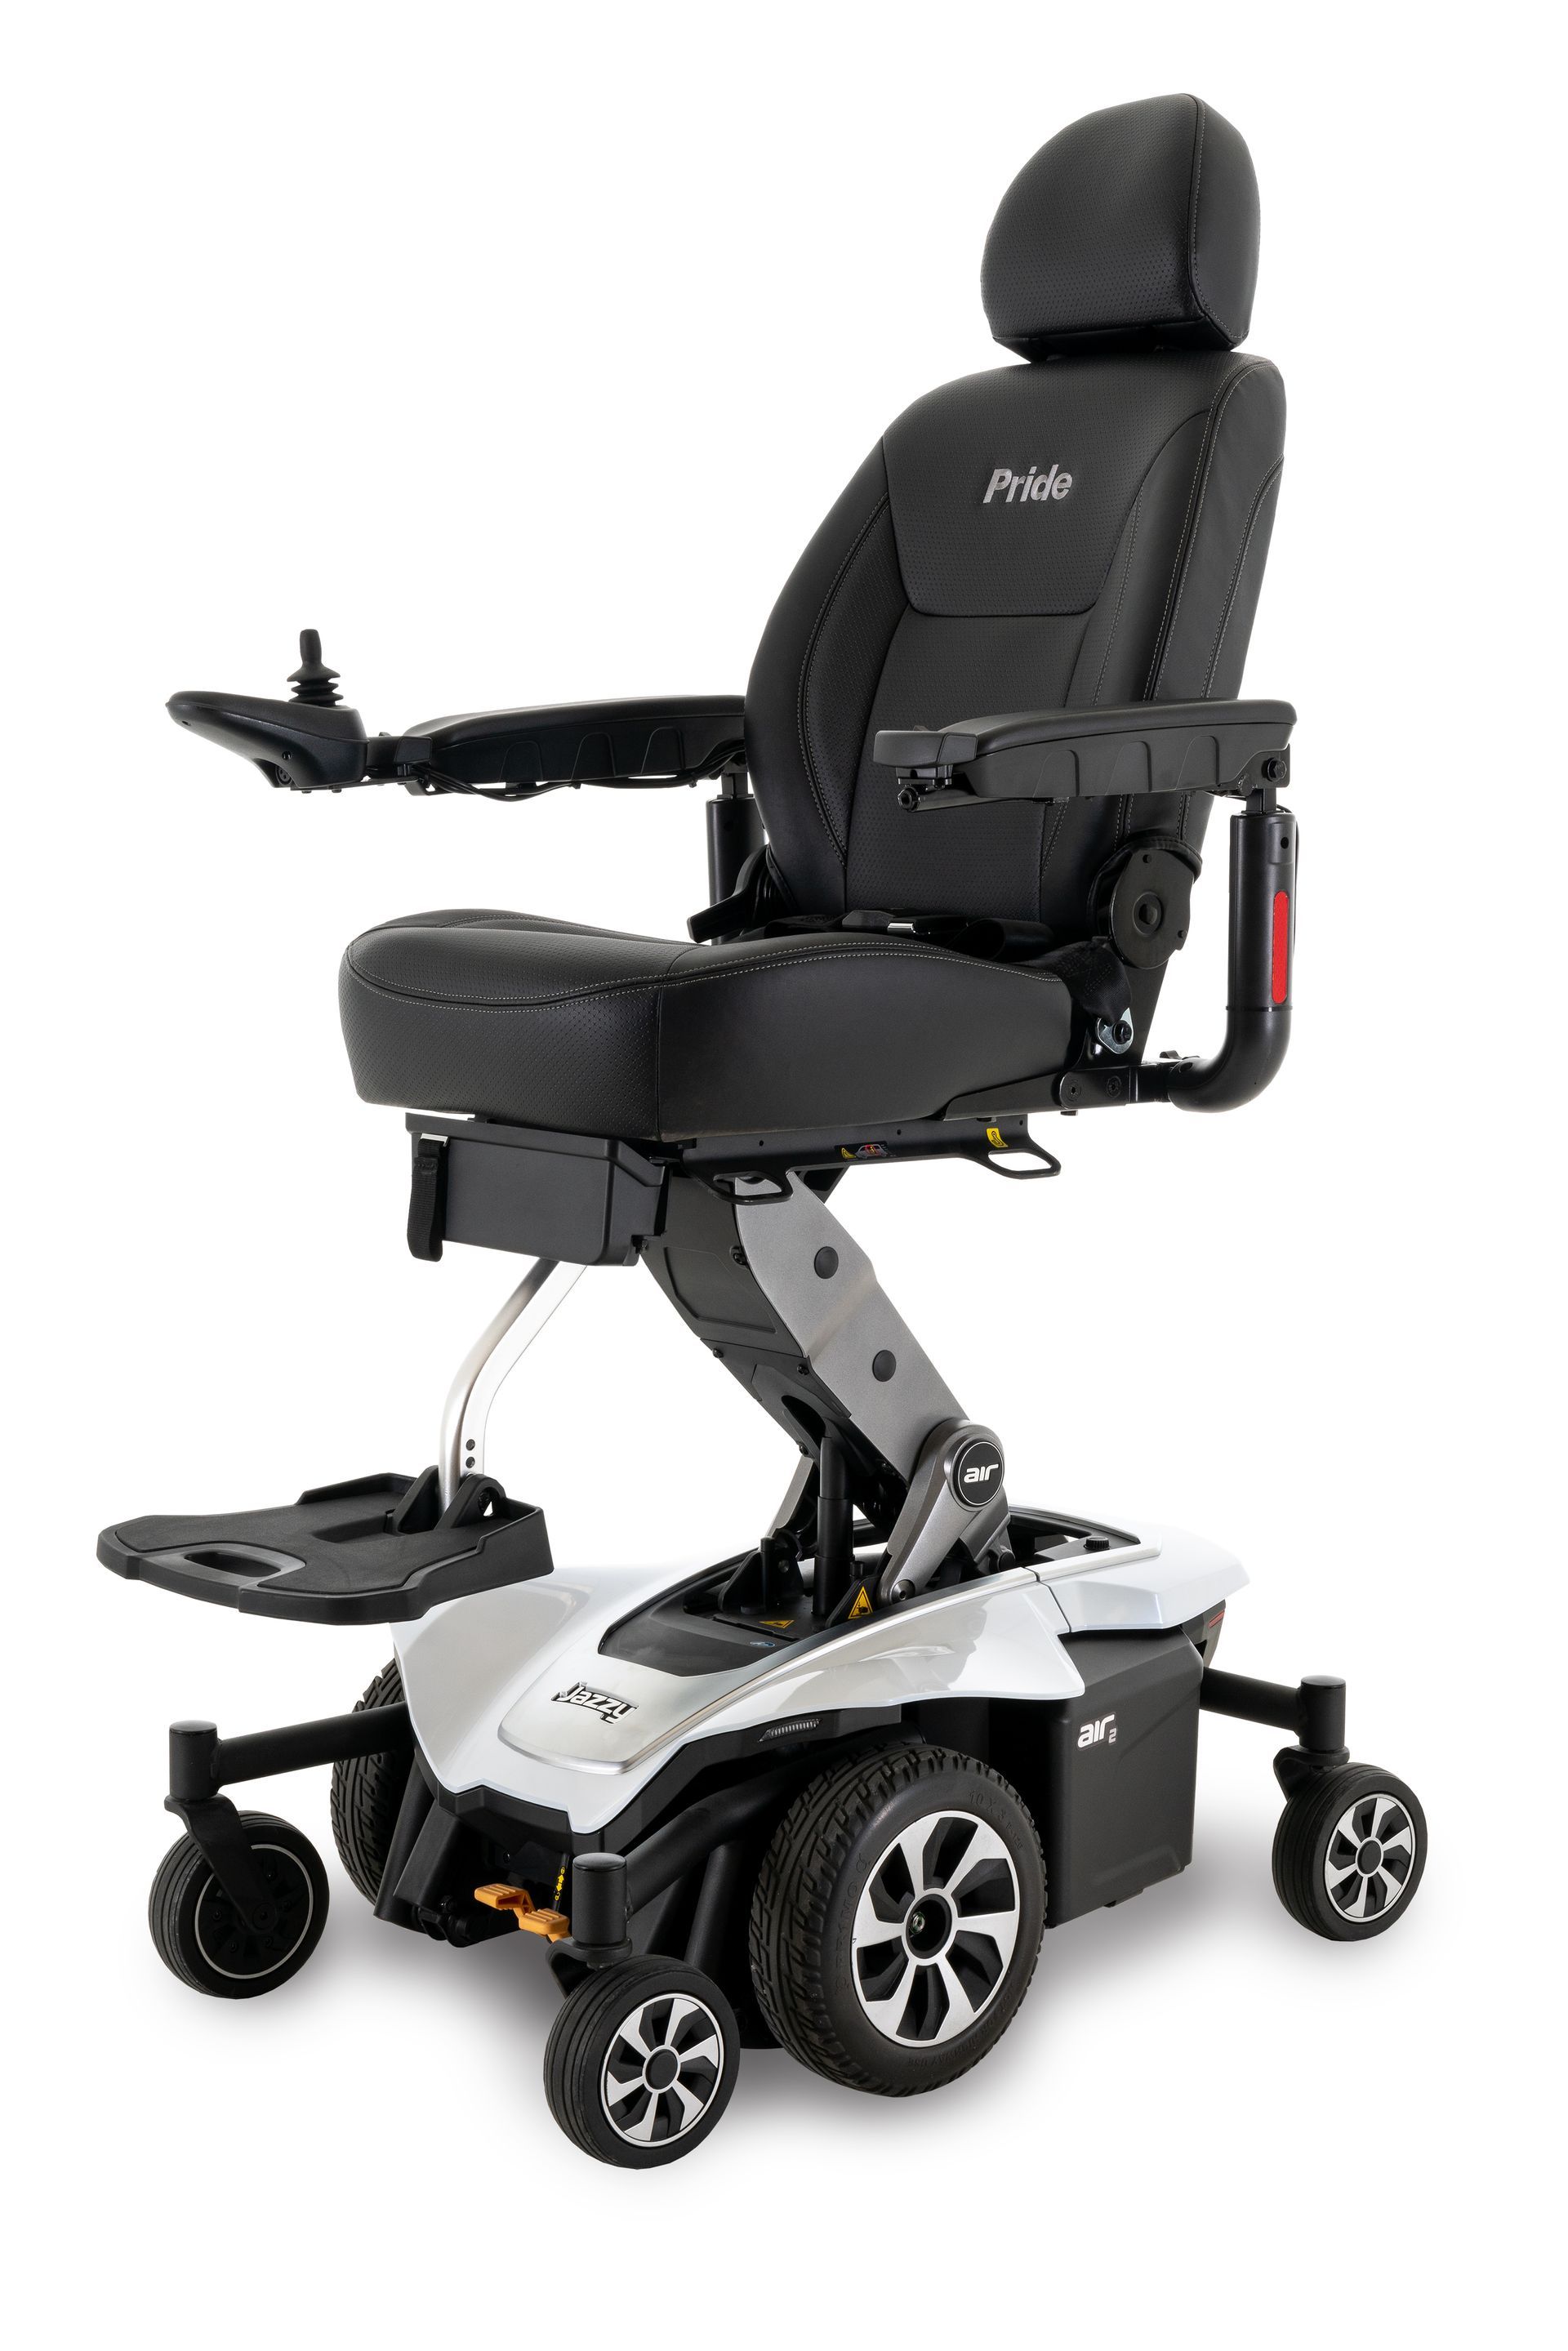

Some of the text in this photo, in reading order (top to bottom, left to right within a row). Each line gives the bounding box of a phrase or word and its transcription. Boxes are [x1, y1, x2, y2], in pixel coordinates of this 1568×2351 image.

[982, 464, 1073, 504] Pride
[964, 1463, 1000, 1484] air
[551, 1683, 638, 1725] Jazzy
[1077, 1714, 1117, 1748] air 2
